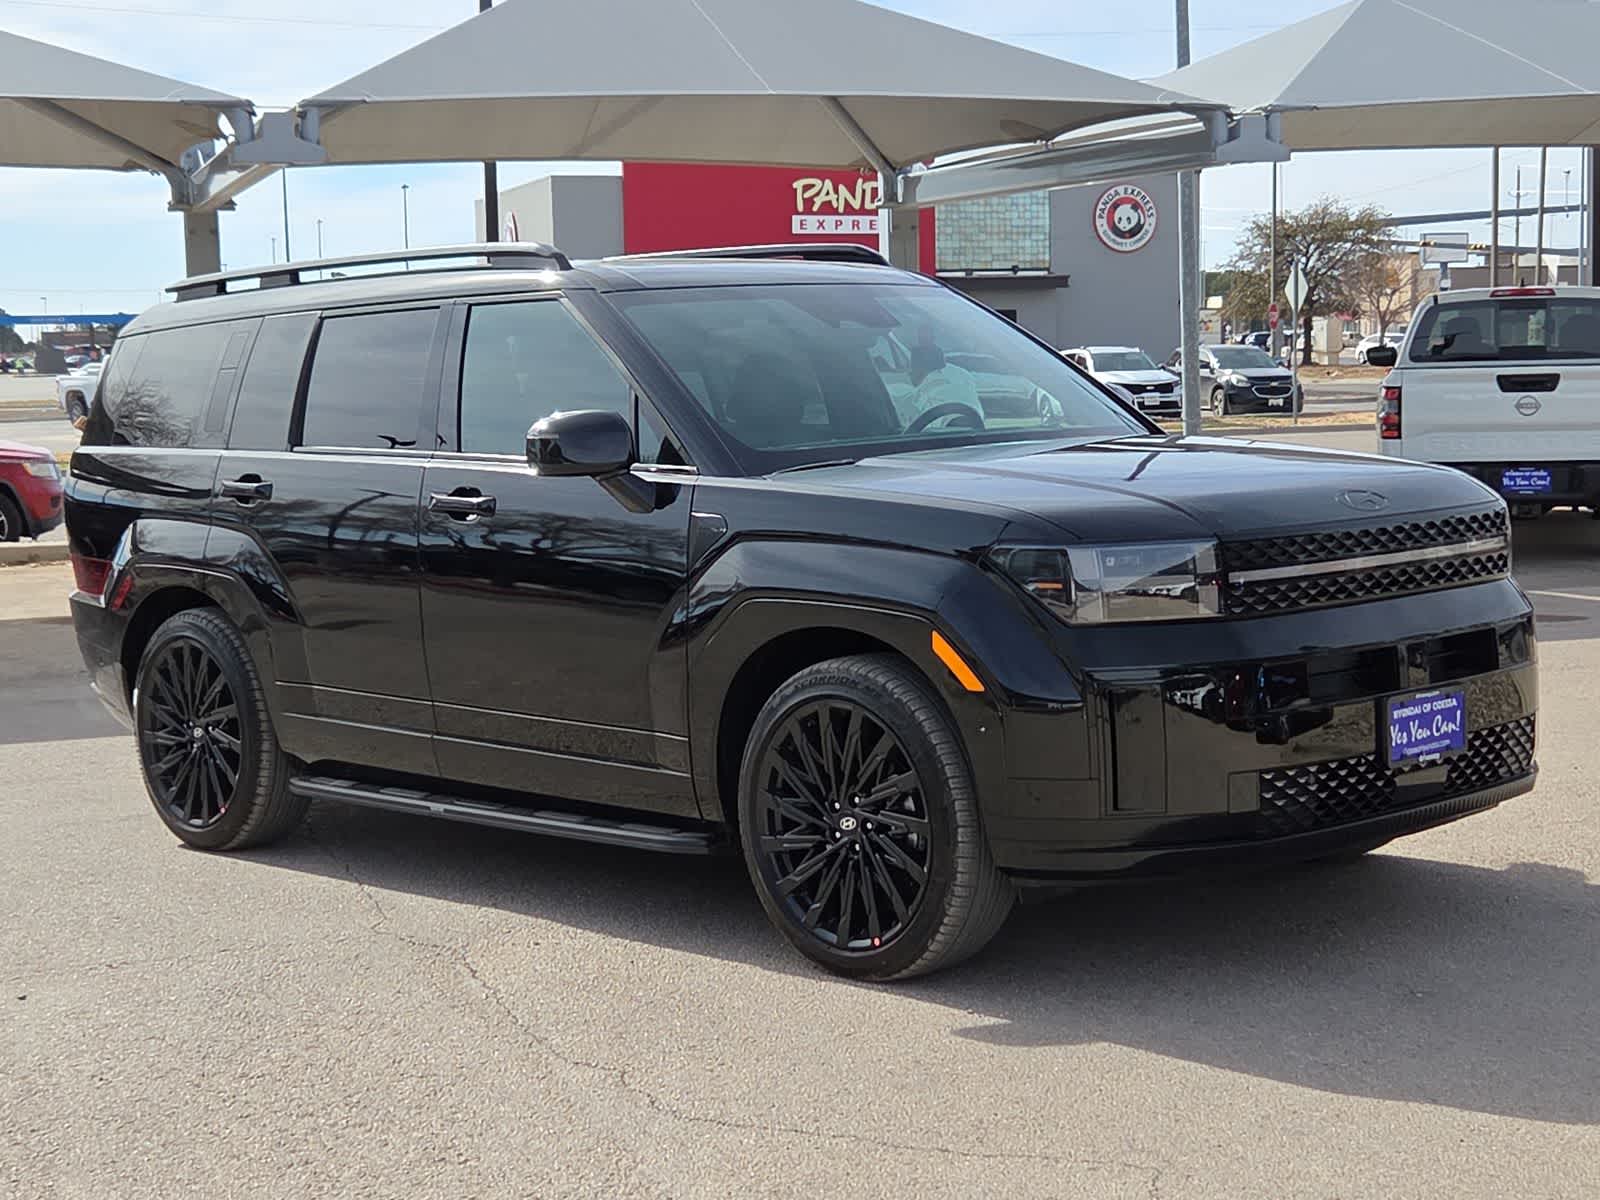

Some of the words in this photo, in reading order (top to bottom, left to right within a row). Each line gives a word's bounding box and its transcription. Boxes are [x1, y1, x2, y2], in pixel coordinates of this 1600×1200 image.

[1098, 189, 1120, 219] PANDA
[1124, 187, 1154, 218] EXPRESS
[799, 219, 877, 231] EXPRE
[1422, 702, 1431, 713] OF
[1390, 723, 1408, 746] Yes
[1409, 719, 1430, 742] You
[1432, 709, 1461, 737] Can!
